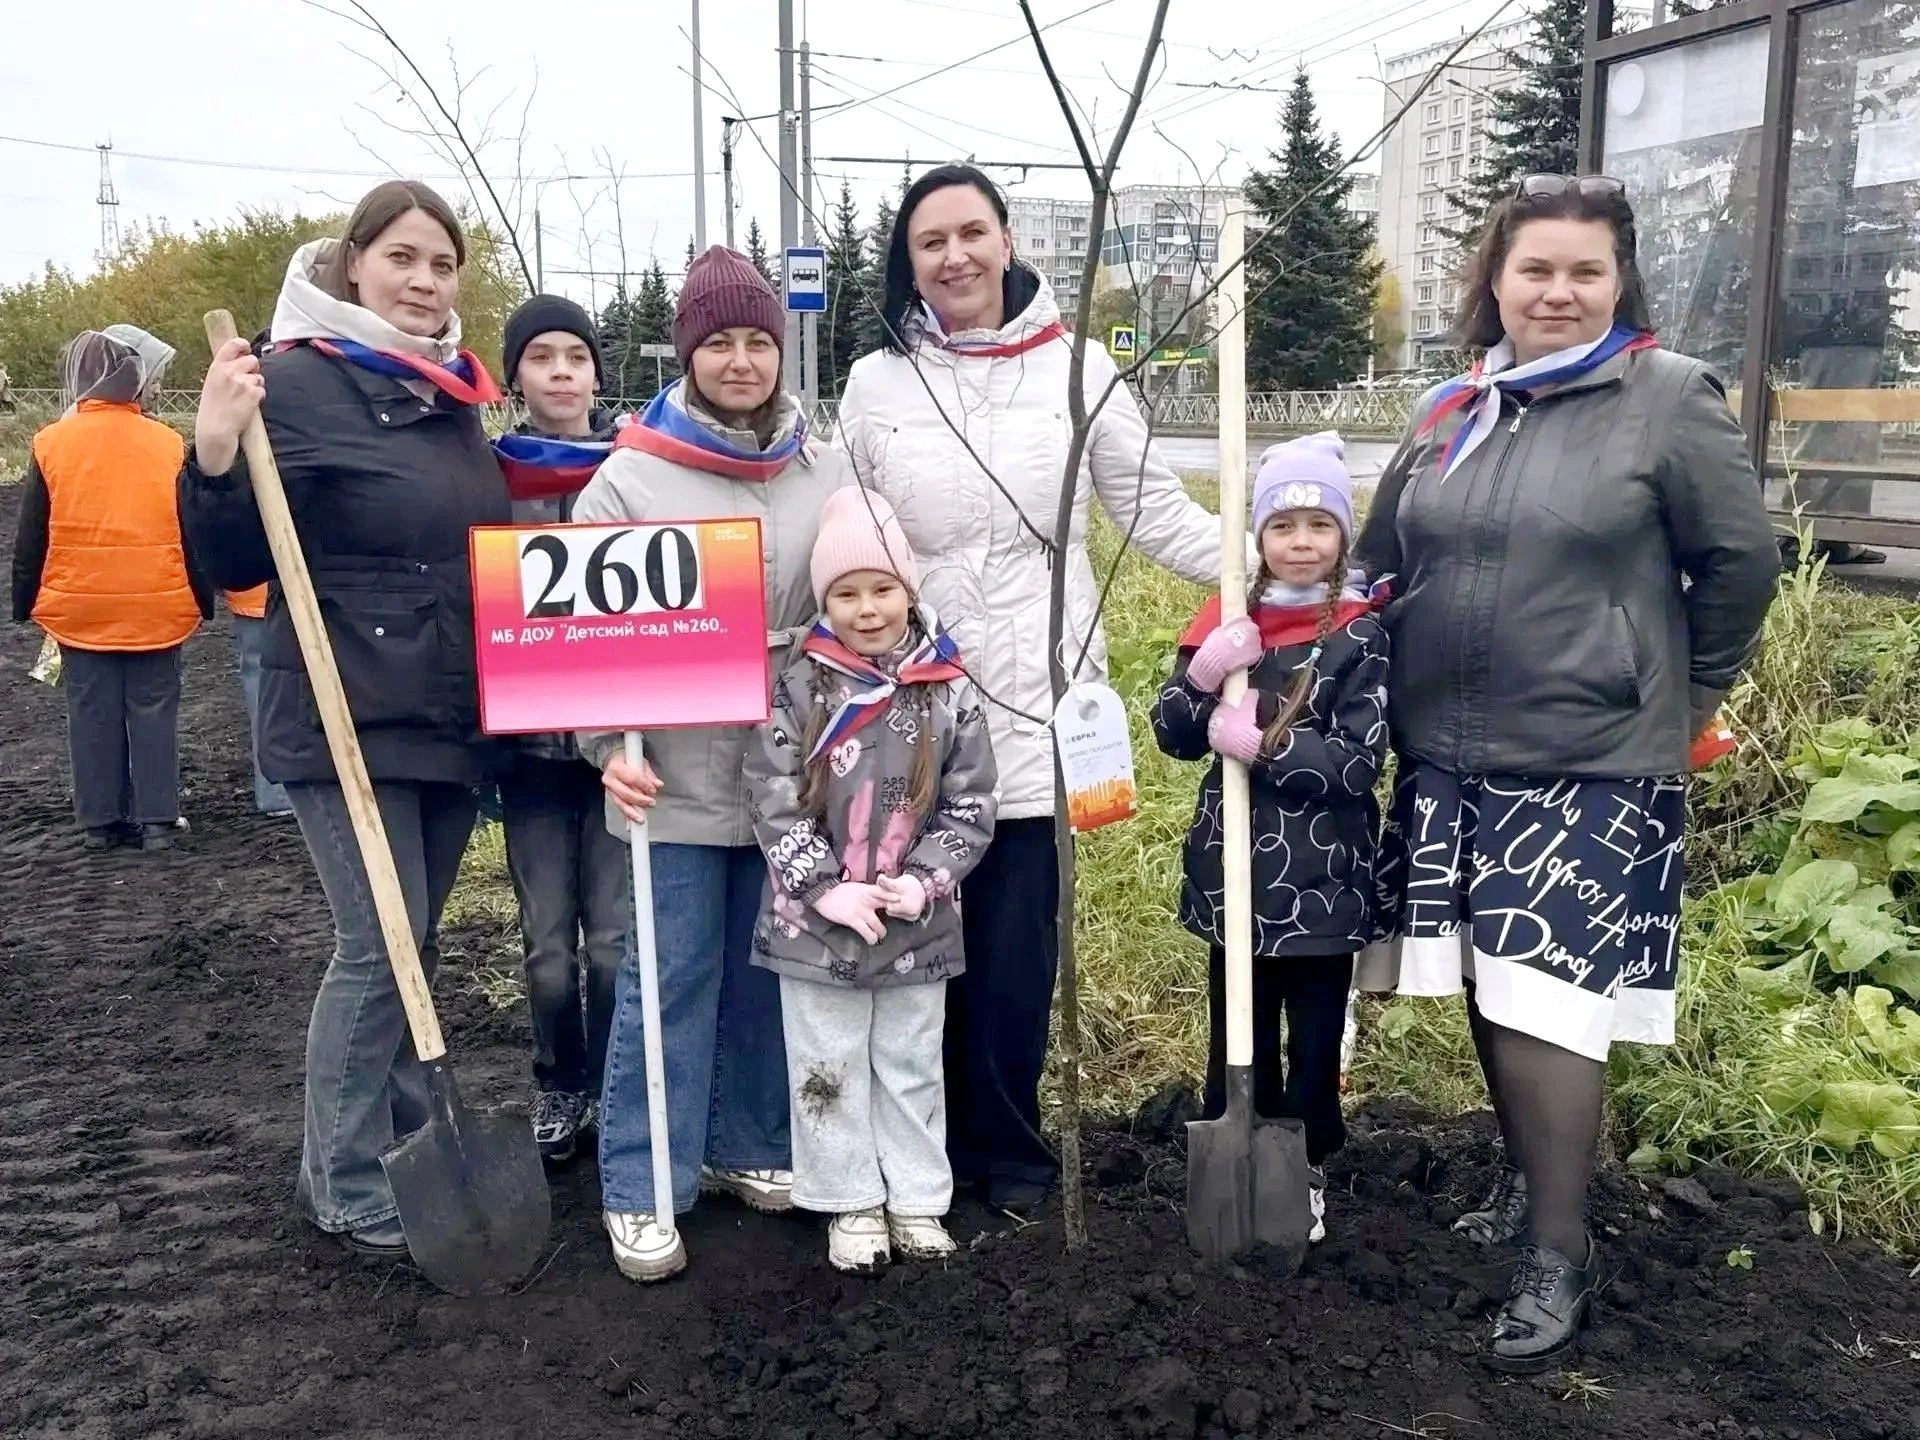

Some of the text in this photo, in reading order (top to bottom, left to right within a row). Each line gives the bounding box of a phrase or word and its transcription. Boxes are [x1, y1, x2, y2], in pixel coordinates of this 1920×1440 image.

[521, 527, 698, 619] 260
[491, 628, 515, 644] МБ
[520, 626, 555, 645] ДОУ
[640, 624, 669, 637] сад
